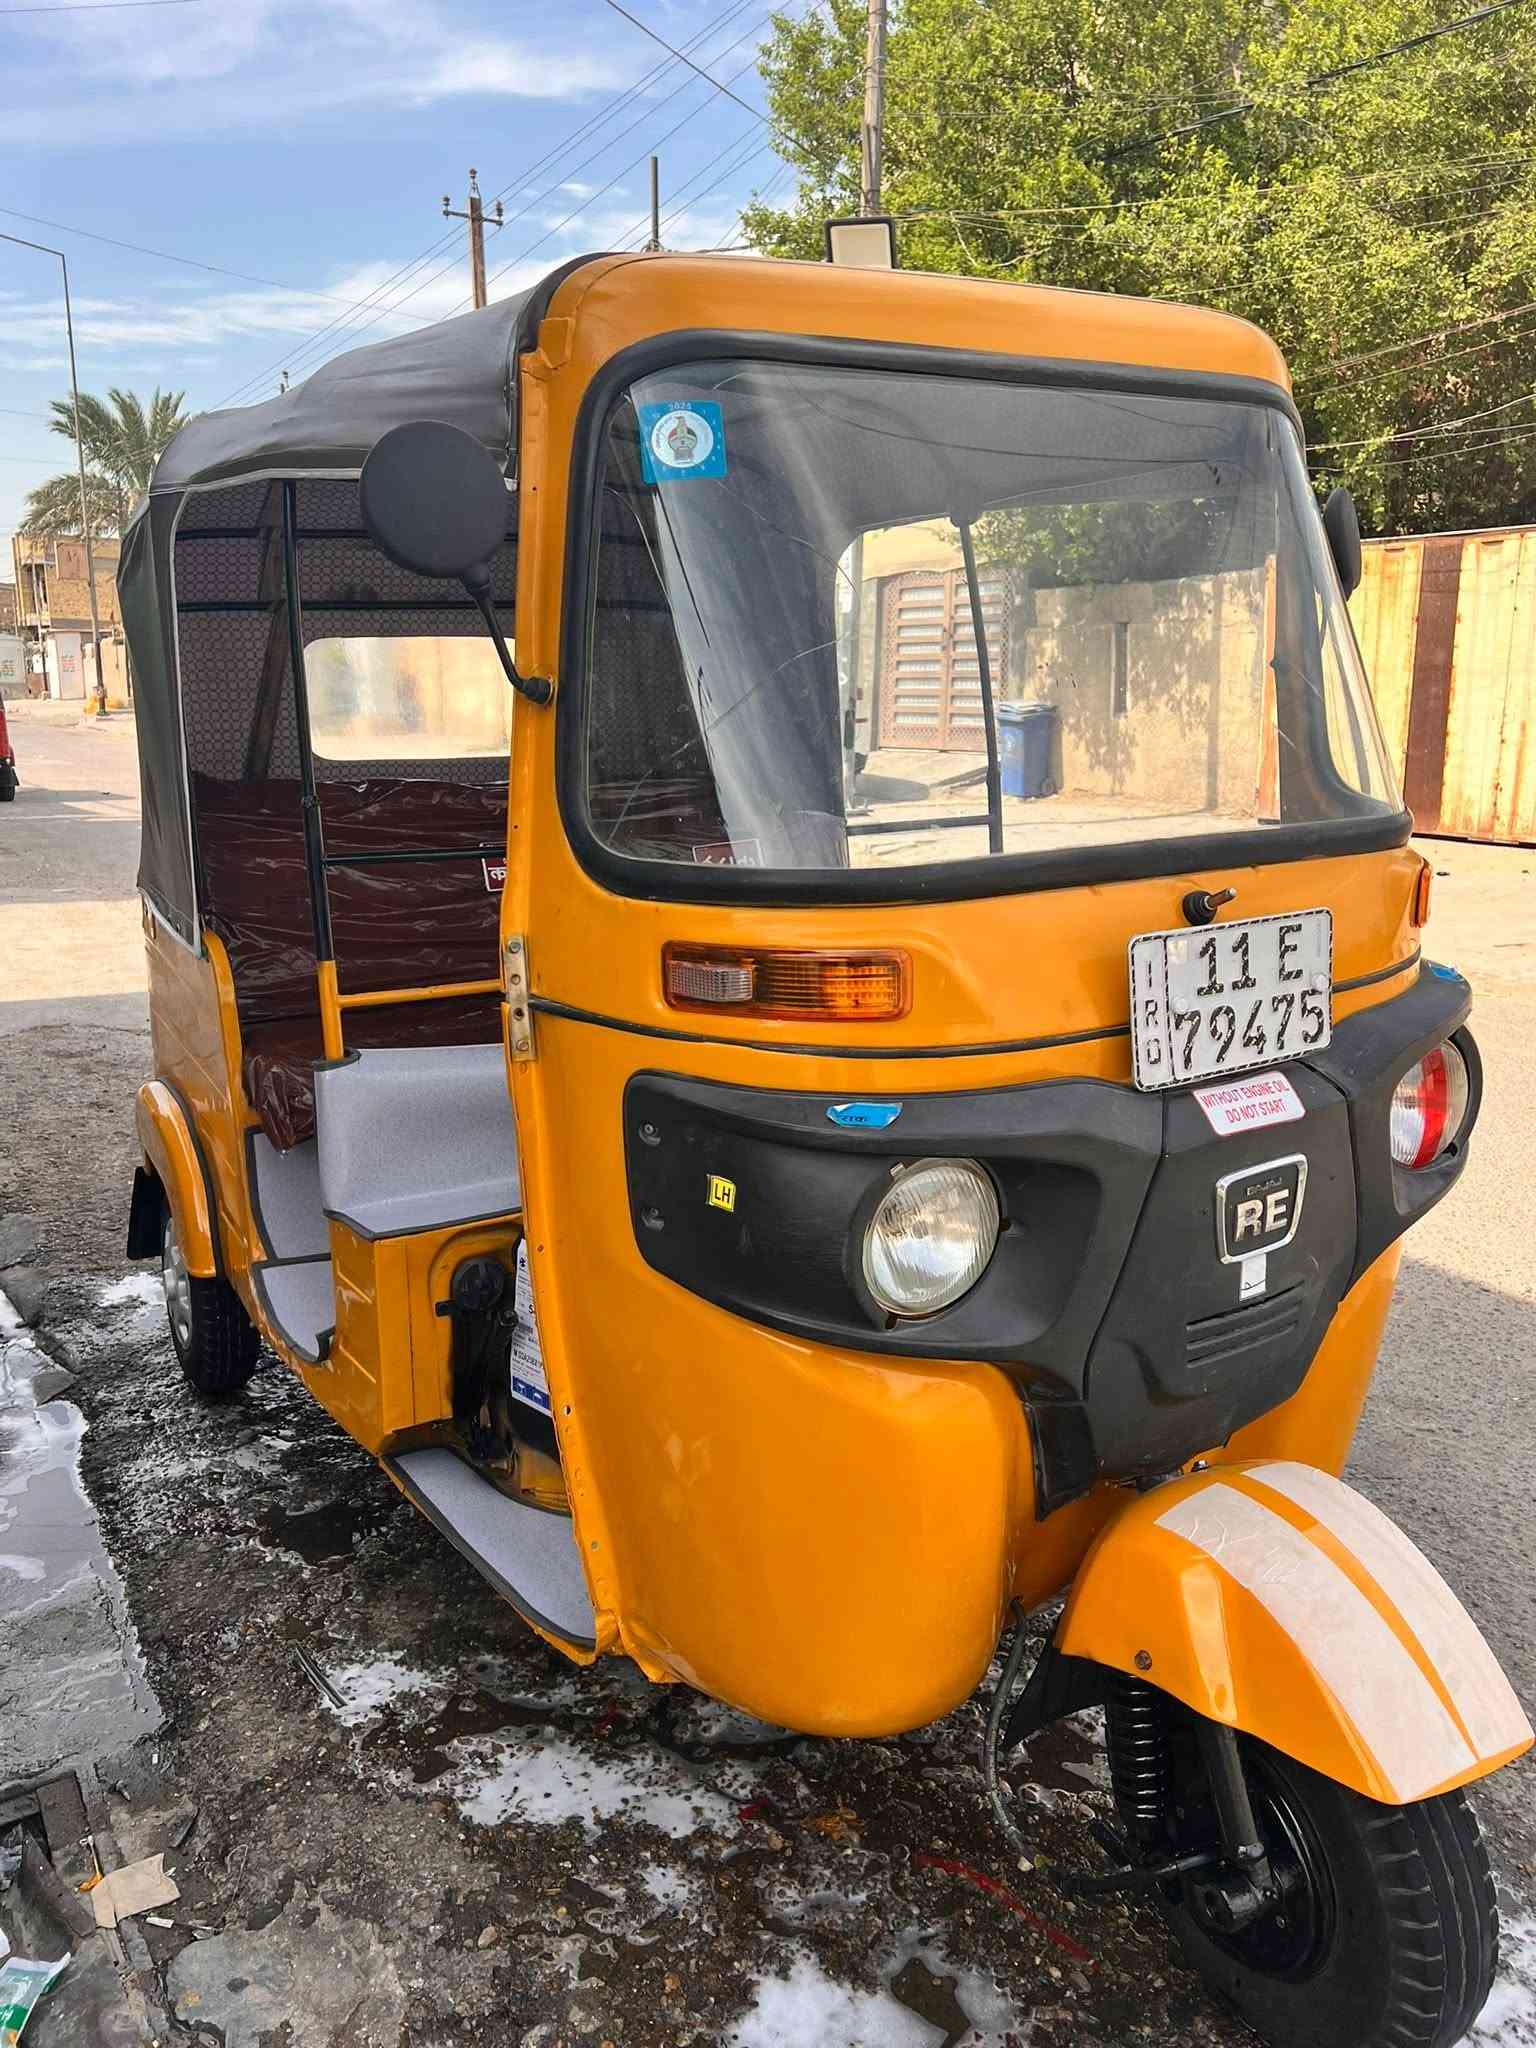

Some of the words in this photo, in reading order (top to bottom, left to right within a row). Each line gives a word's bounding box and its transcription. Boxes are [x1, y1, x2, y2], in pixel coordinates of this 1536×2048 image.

[1197, 932, 1256, 996] 11
[1279, 923, 1303, 981] E
[1173, 988, 1324, 1070] 79475
[1201, 1087, 1242, 1108] WITHOUT
[1242, 1082, 1274, 1099] ENGINE
[1272, 1080, 1290, 1093] OIL
[1225, 1109, 1241, 1123] DO
[1240, 1103, 1258, 1120] NOT
[1258, 1099, 1286, 1116] START
[714, 1183, 731, 1203] LH
[1234, 1189, 1289, 1242] RE
